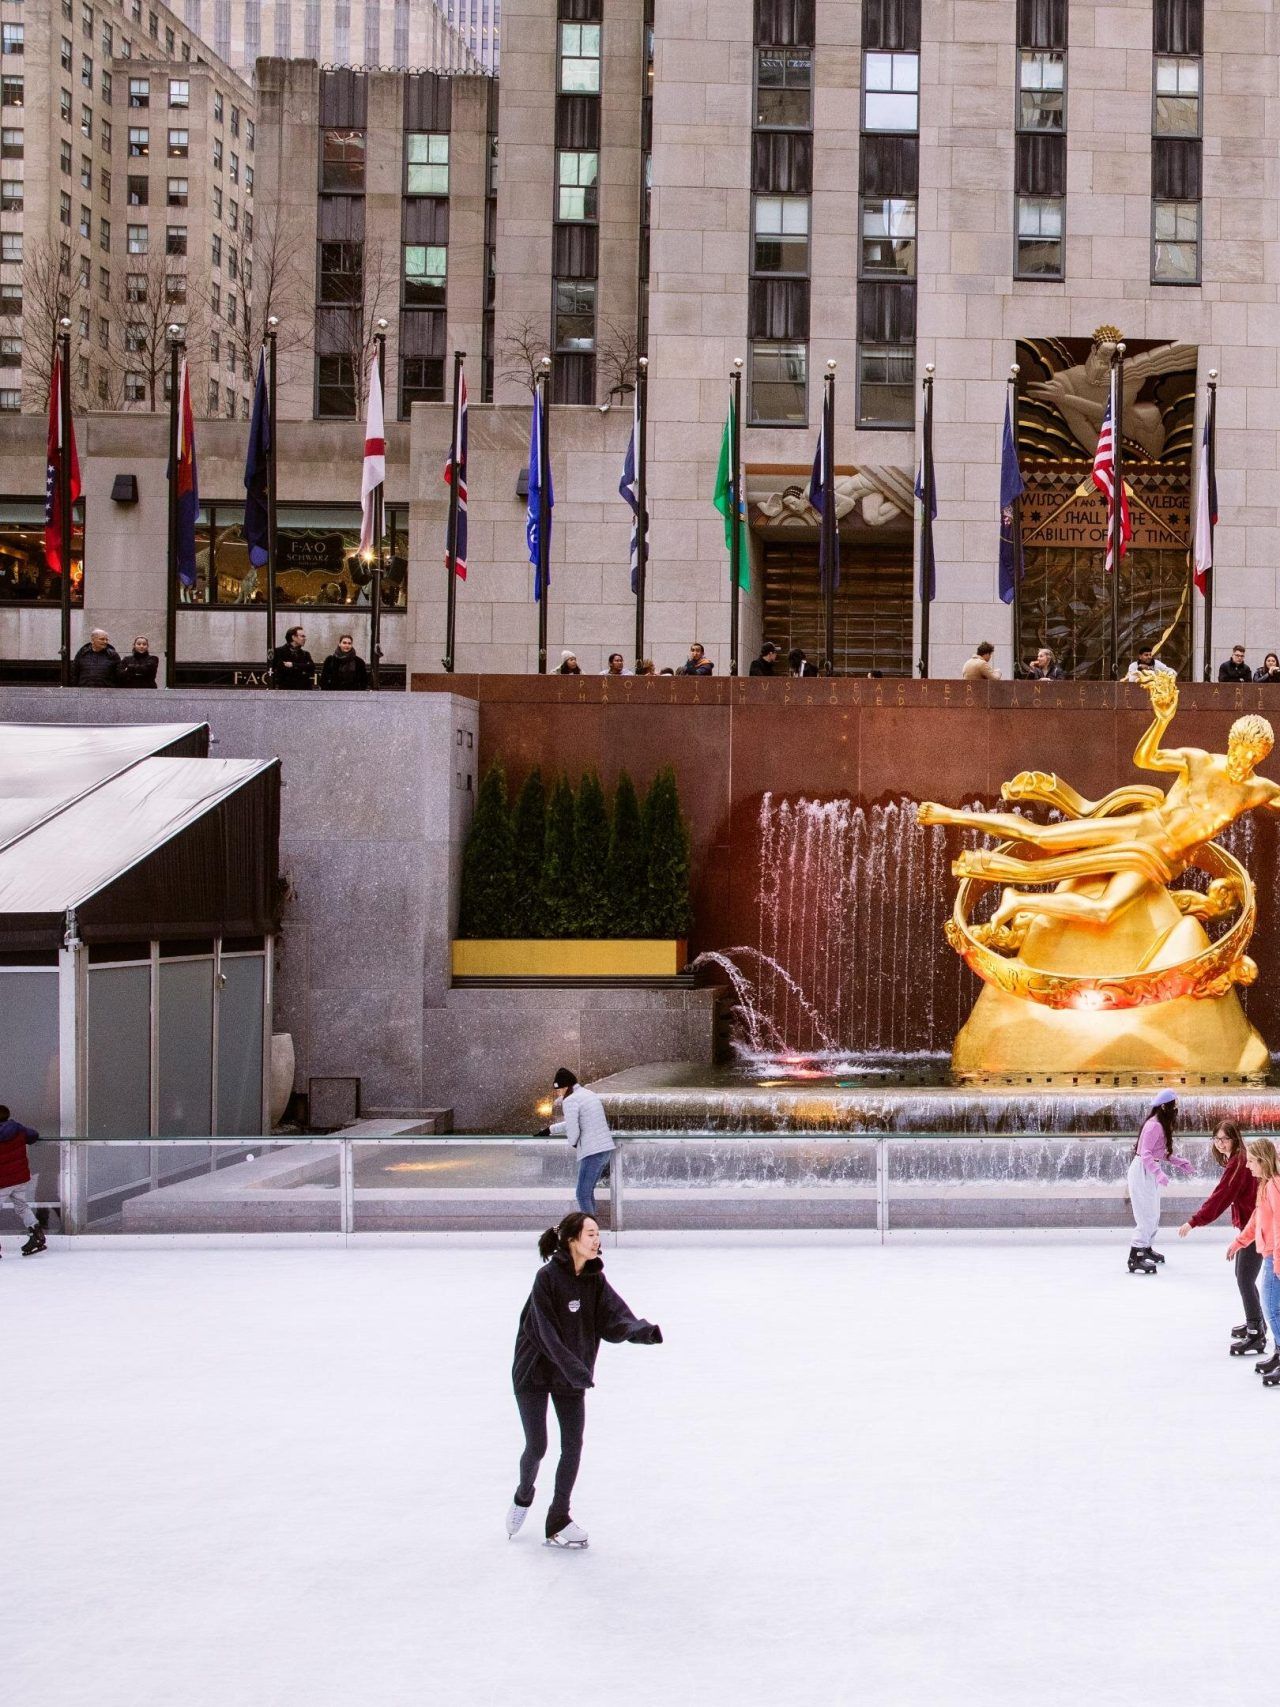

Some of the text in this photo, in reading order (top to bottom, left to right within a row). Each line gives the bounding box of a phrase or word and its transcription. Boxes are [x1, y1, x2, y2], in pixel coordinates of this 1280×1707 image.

[1081, 499, 1096, 507] AND
[1063, 511, 1101, 525] SHALL
[1213, 687, 1264, 697] ART
